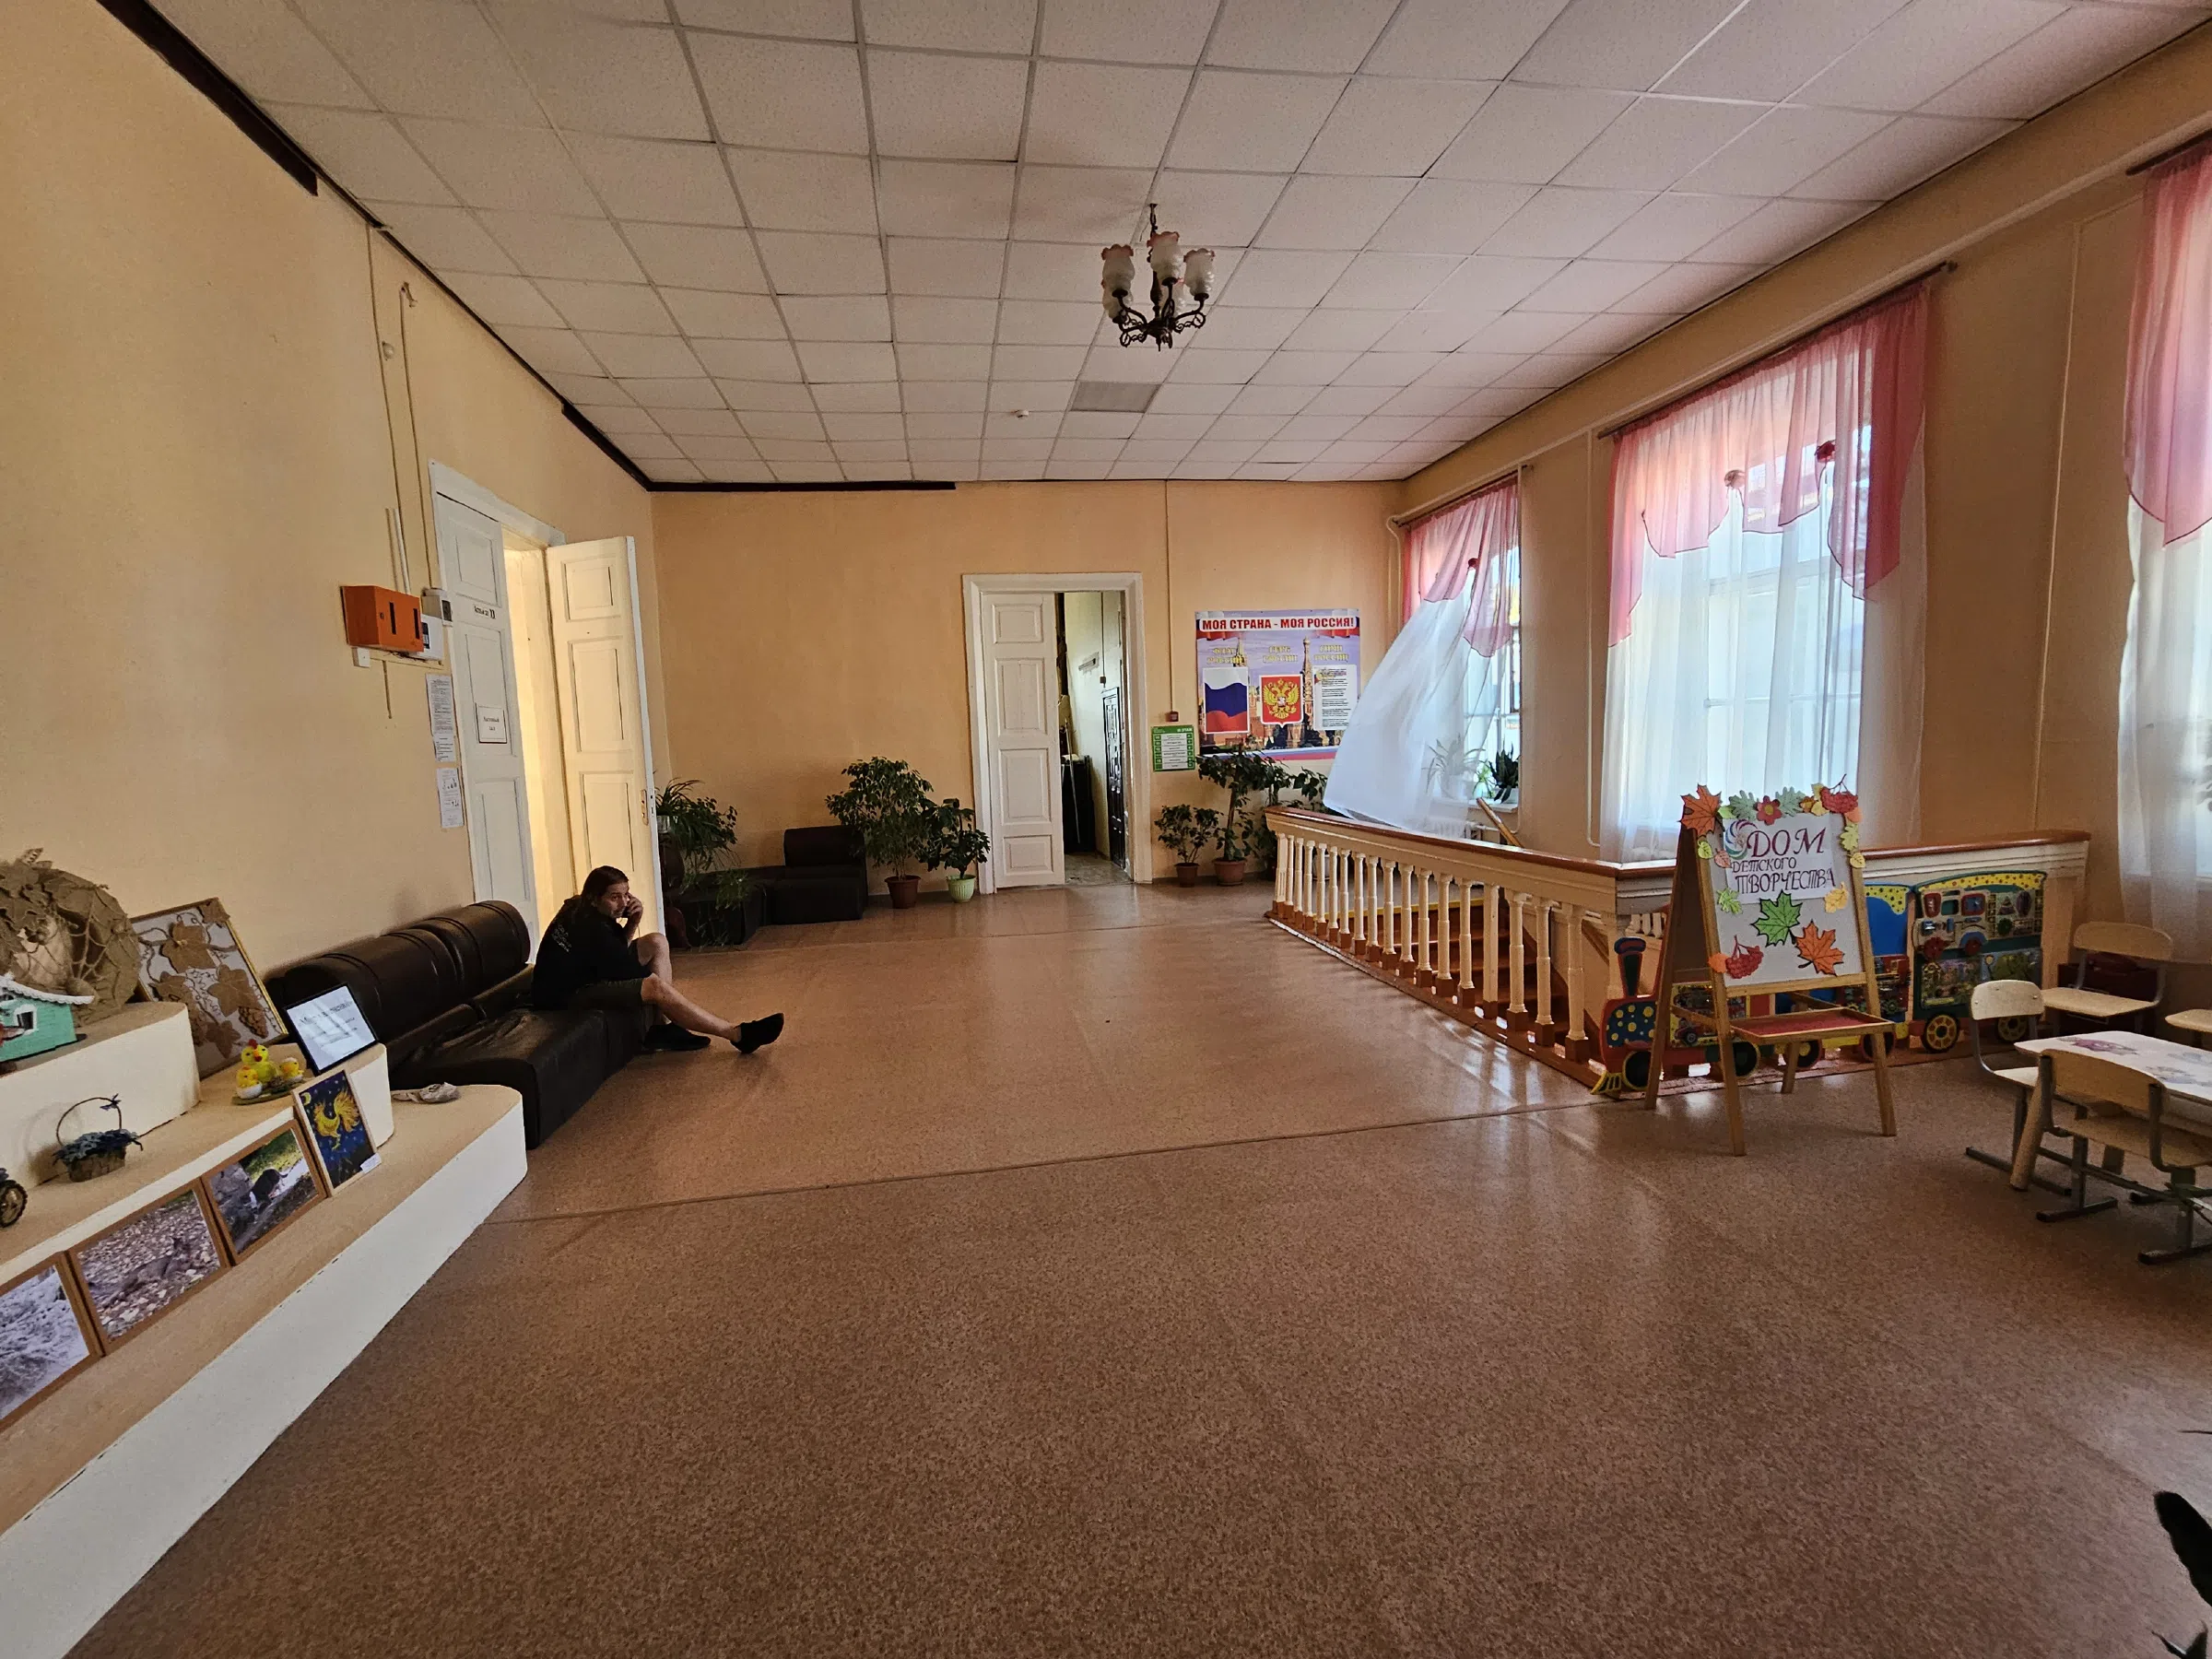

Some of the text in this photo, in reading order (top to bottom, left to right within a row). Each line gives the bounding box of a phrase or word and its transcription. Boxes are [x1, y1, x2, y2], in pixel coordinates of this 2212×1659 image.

[1202, 619, 1227, 630] МОЯ
[1230, 618, 1272, 629] СТРАНА
[1280, 618, 1304, 629] МОЯ
[1307, 617, 1354, 628] РОССИЯ!
[1747, 827, 1827, 858] ДОМ
[1731, 857, 1796, 873] ДЕТСКОГО
[1735, 867, 1836, 894] ТВОРЧЕСТВА
